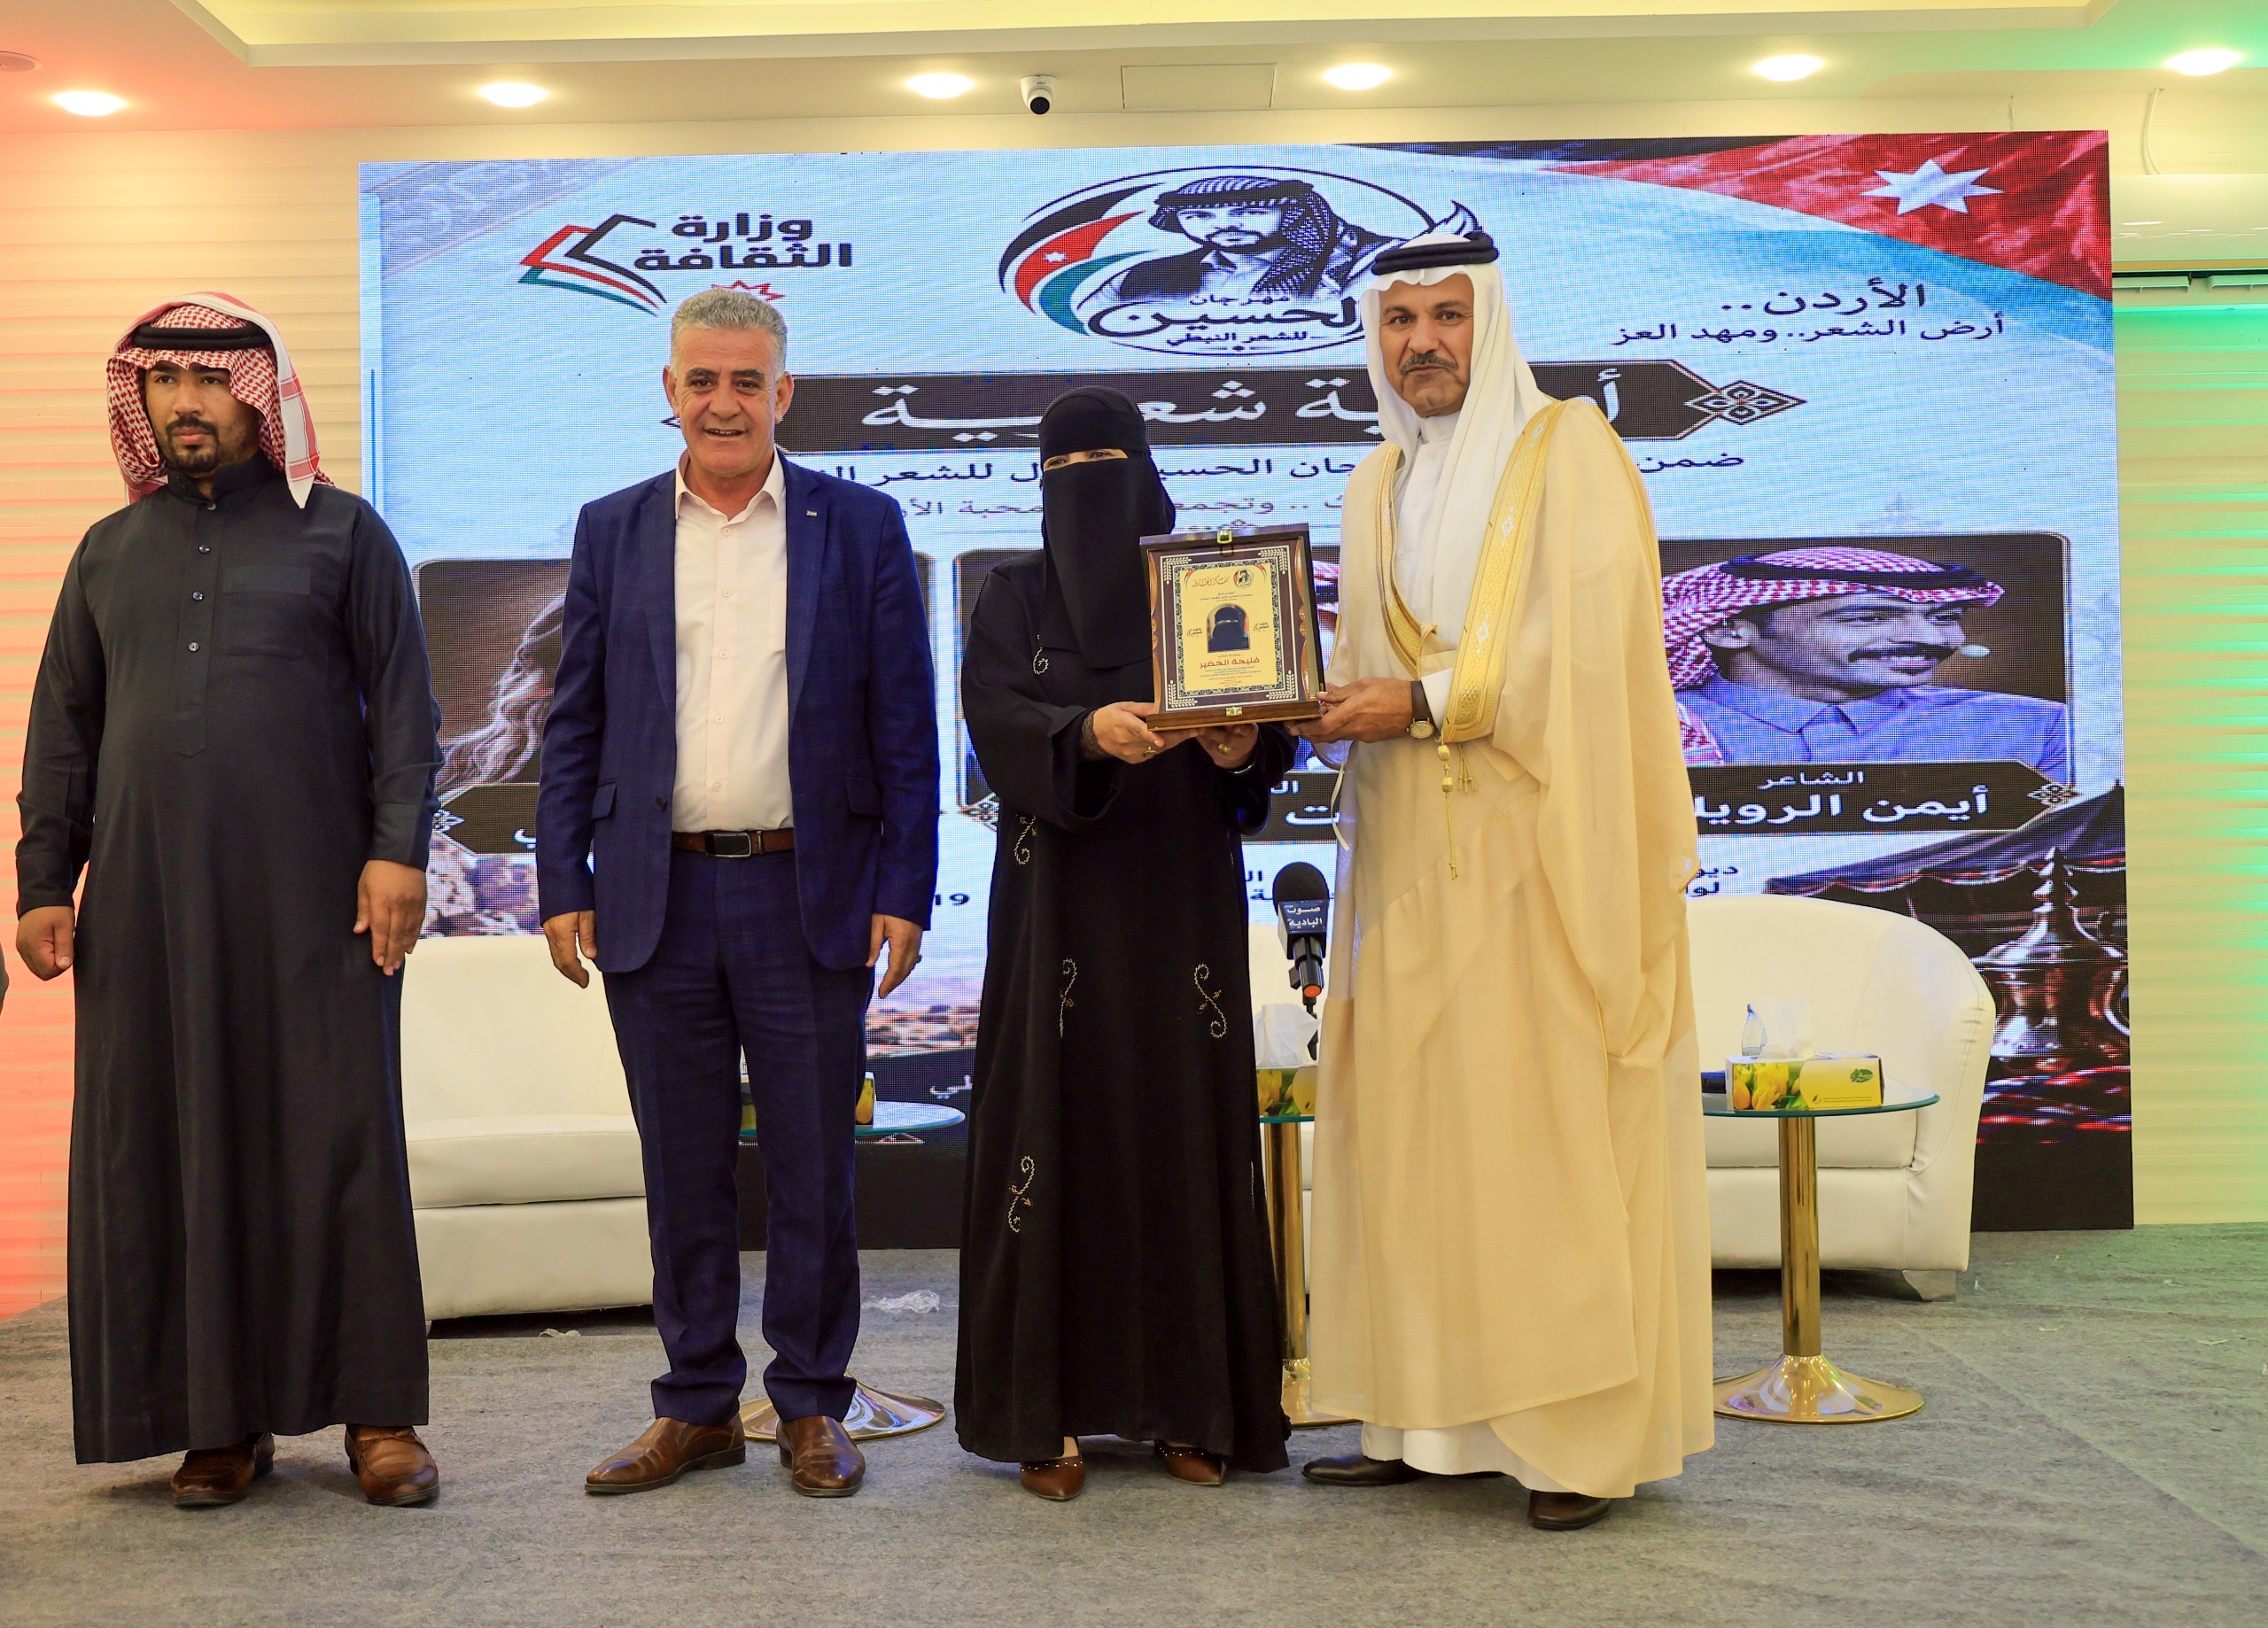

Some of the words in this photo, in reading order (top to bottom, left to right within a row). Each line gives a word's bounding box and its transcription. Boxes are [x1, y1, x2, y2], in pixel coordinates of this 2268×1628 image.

[672, 213, 812, 241] وزارة
[633, 243, 852, 270] الثقافة
[1088, 296, 1364, 337] لحسين
[1919, 311, 2005, 341] أرض
[1167, 332, 1237, 345] النبطي
[1242, 330, 1308, 343] للشعر
[1611, 322, 1678, 346] العز
[1690, 326, 1778, 343] ومهد
[870, 462, 993, 487] للشعر
[1159, 457, 1273, 481] الحسي
[1638, 453, 1745, 475] ضمن
[1200, 658, 1230, 670] الخضير
[1231, 656, 1260, 666] فليحة
[1758, 770, 1864, 790] الشاعر
[1693, 794, 1842, 826] الرويل
[1862, 785, 1989, 822] أيمن
[1286, 904, 1321, 916] صوت
[1287, 917, 1323, 929] البادية
